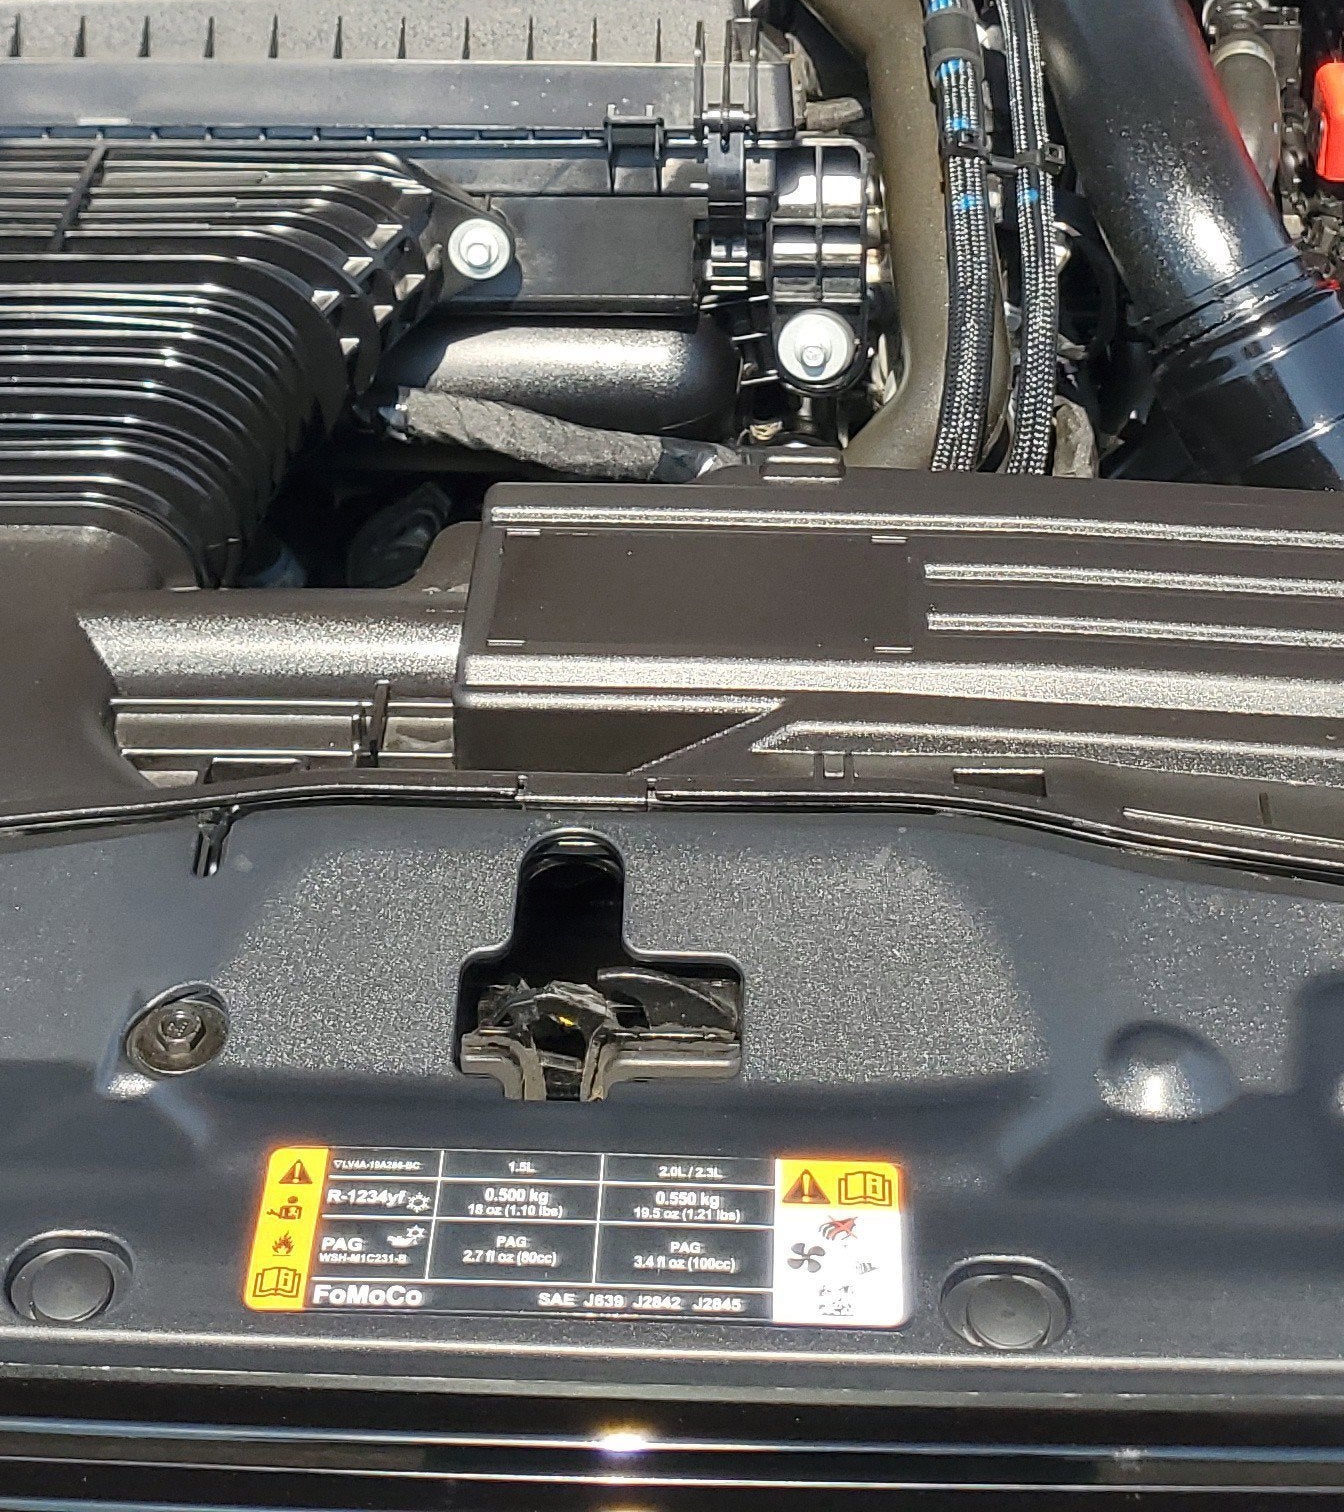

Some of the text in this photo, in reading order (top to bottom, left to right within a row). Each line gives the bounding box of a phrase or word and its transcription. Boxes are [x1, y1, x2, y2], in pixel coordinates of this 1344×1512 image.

[327, 1189, 407, 1208] R-1234yf
[484, 1187, 550, 1205] 0.500 kg
[656, 1191, 721, 1209] 0.550 kg
[485, 1205, 503, 1216] oz
[505, 1203, 537, 1218] (1.10
[663, 1209, 680, 1220] oz
[682, 1208, 712, 1222] (1.21
[716, 1209, 741, 1224] lbs)
[321, 1236, 364, 1252] PAG
[495, 1235, 528, 1248] PAG
[669, 1241, 701, 1254] PAG
[462, 1249, 484, 1264] 2.7
[485, 1250, 496, 1263] fl
[498, 1251, 514, 1263] oz
[632, 1254, 736, 1273] 3.4 fl oz (100cc)
[312, 1284, 424, 1307] FoMoCo
[538, 1292, 577, 1307] SAE
